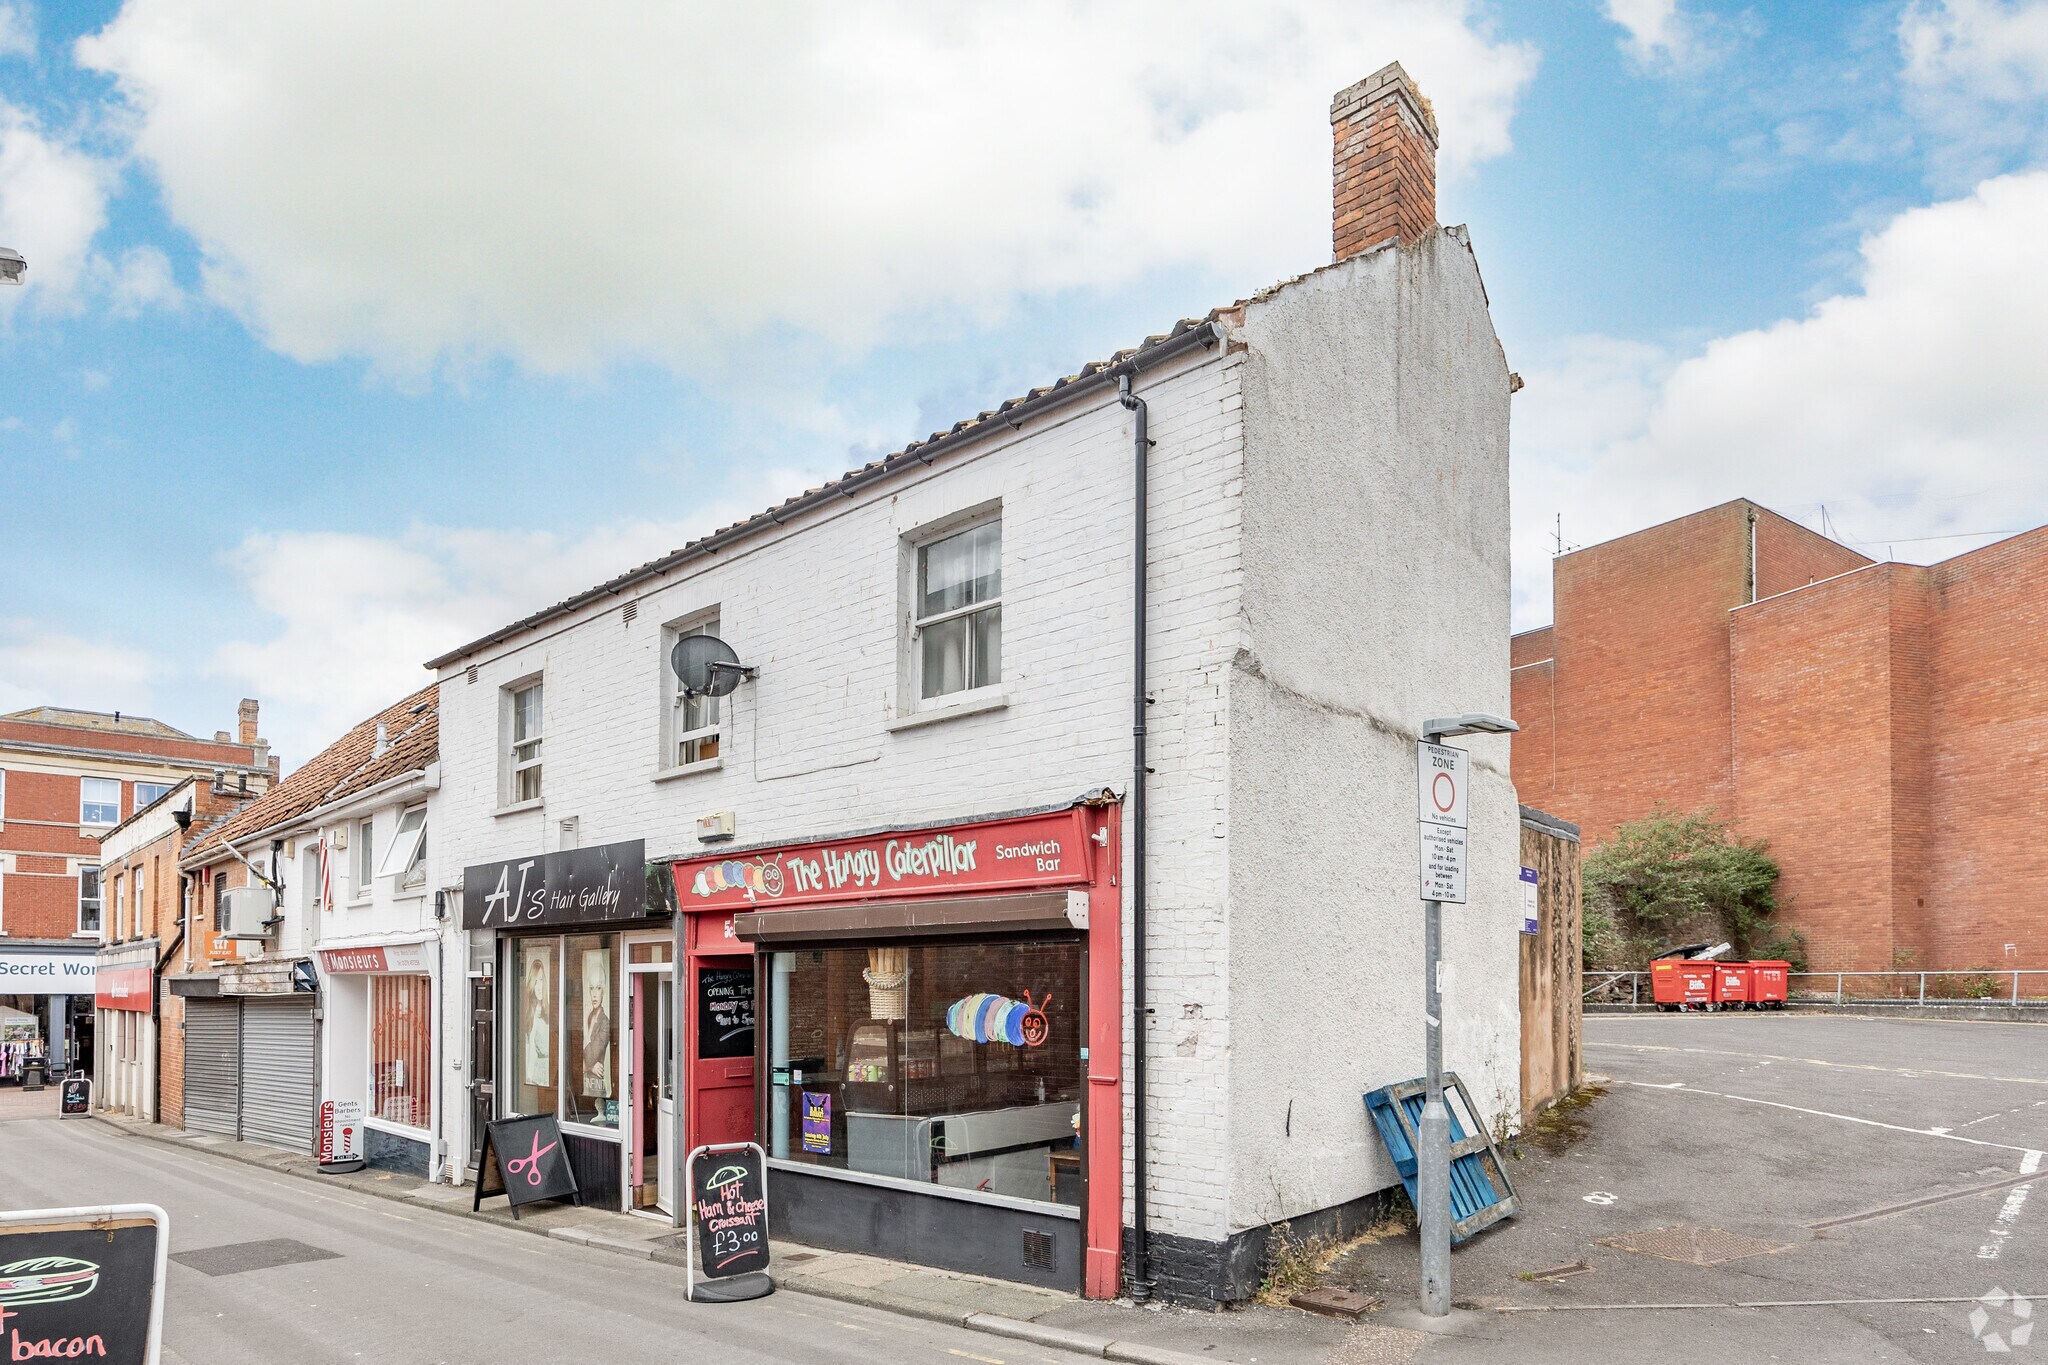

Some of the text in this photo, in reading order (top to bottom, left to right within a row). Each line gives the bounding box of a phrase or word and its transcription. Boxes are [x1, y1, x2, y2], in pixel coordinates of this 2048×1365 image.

[1428, 746, 1459, 758] PEDESTRIAN
[1432, 756, 1455, 771] ZONE
[1431, 812, 1456, 823] No vehicles
[1436, 827, 1452, 837] Except
[1423, 834, 1464, 846] authorised vehicles
[995, 839, 1061, 860] Sandwich
[786, 834, 977, 892] The Hungry Caterpillar
[1036, 857, 1061, 872] Bar
[1444, 865, 1459, 874] loading
[1435, 872, 1453, 880] between
[481, 859, 621, 925] AJ's Hair Gallery
[329, 951, 380, 970] Monsieurs
[0, 962, 55, 975] Secret
[707, 985, 735, 997] OPENING
[320, 1102, 334, 1162] Monsieurs
[720, 1180, 744, 1202] Hot
[698, 1199, 724, 1221] Ham
[11, 1328, 107, 1362] bacon
